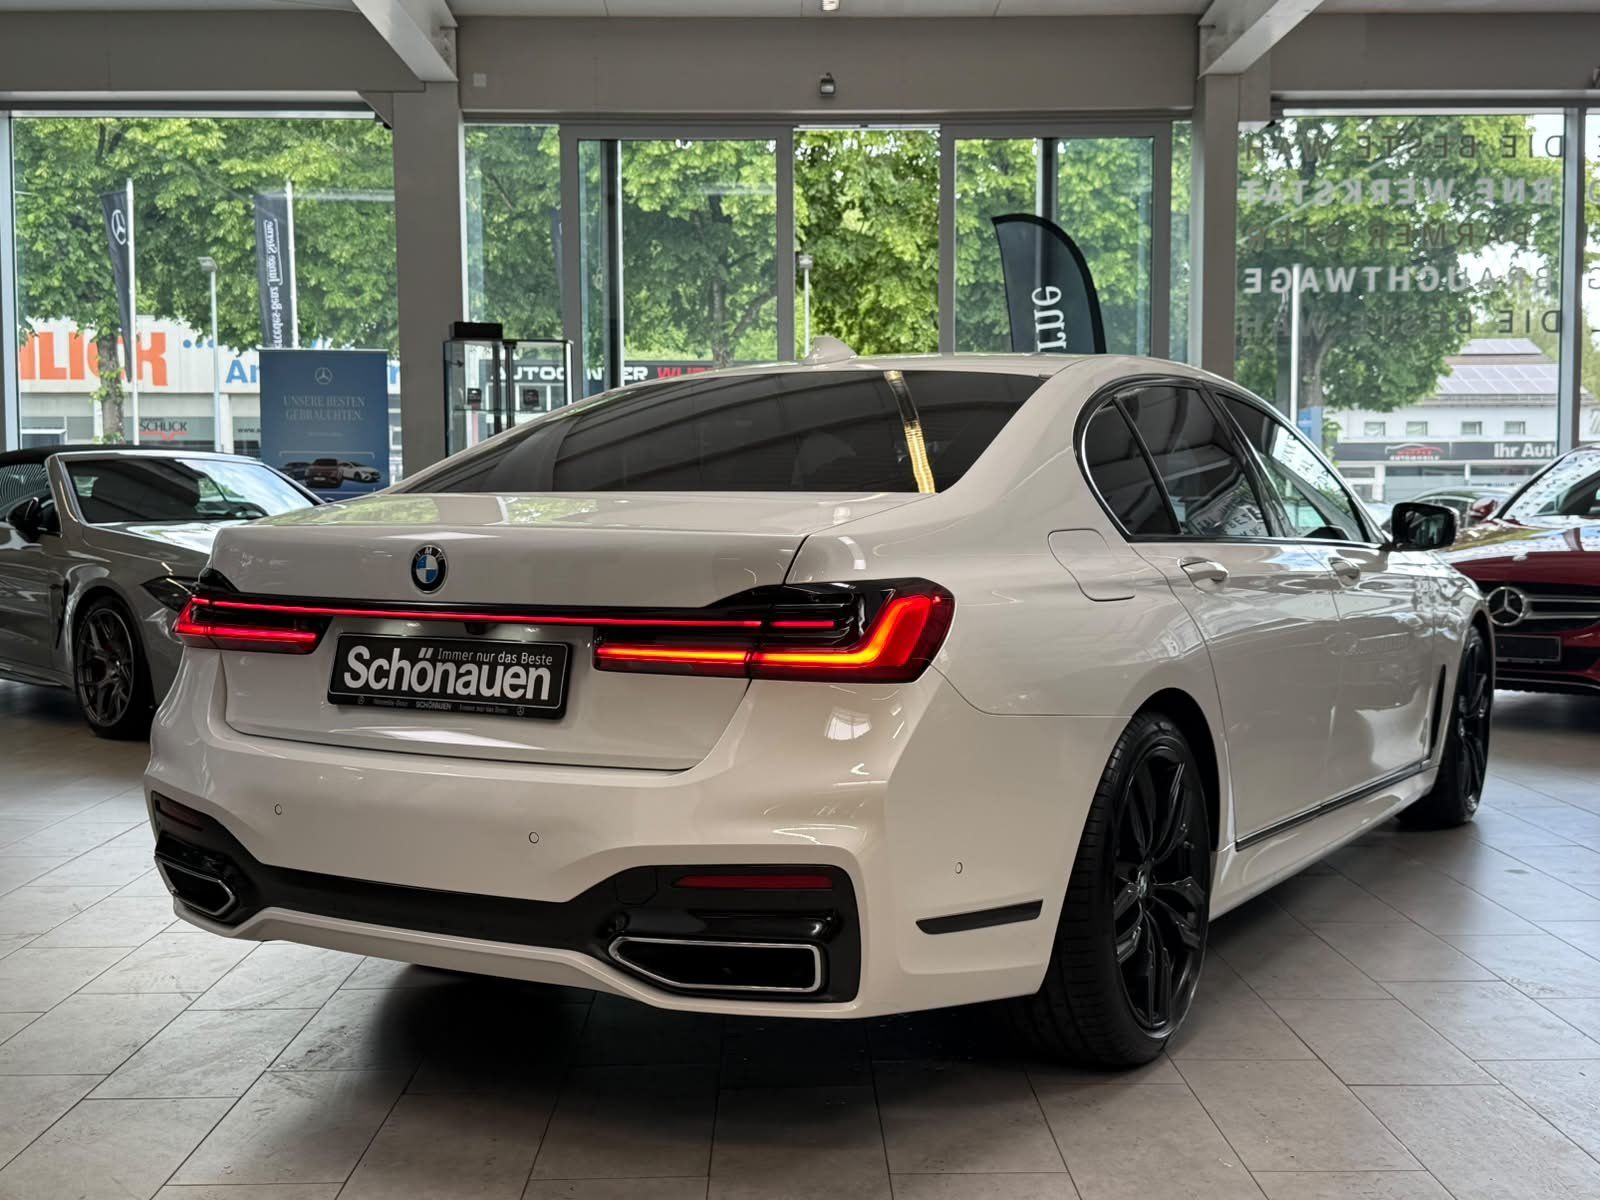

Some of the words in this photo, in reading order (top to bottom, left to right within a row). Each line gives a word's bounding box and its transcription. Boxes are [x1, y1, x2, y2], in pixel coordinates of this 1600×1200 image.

[1494, 443, 1518, 457] Ihr
[438, 648, 474, 661] Immer
[476, 653, 496, 662] nur
[497, 651, 517, 664] das
[521, 652, 553, 666] Beste
[343, 645, 551, 700] Schönauen
